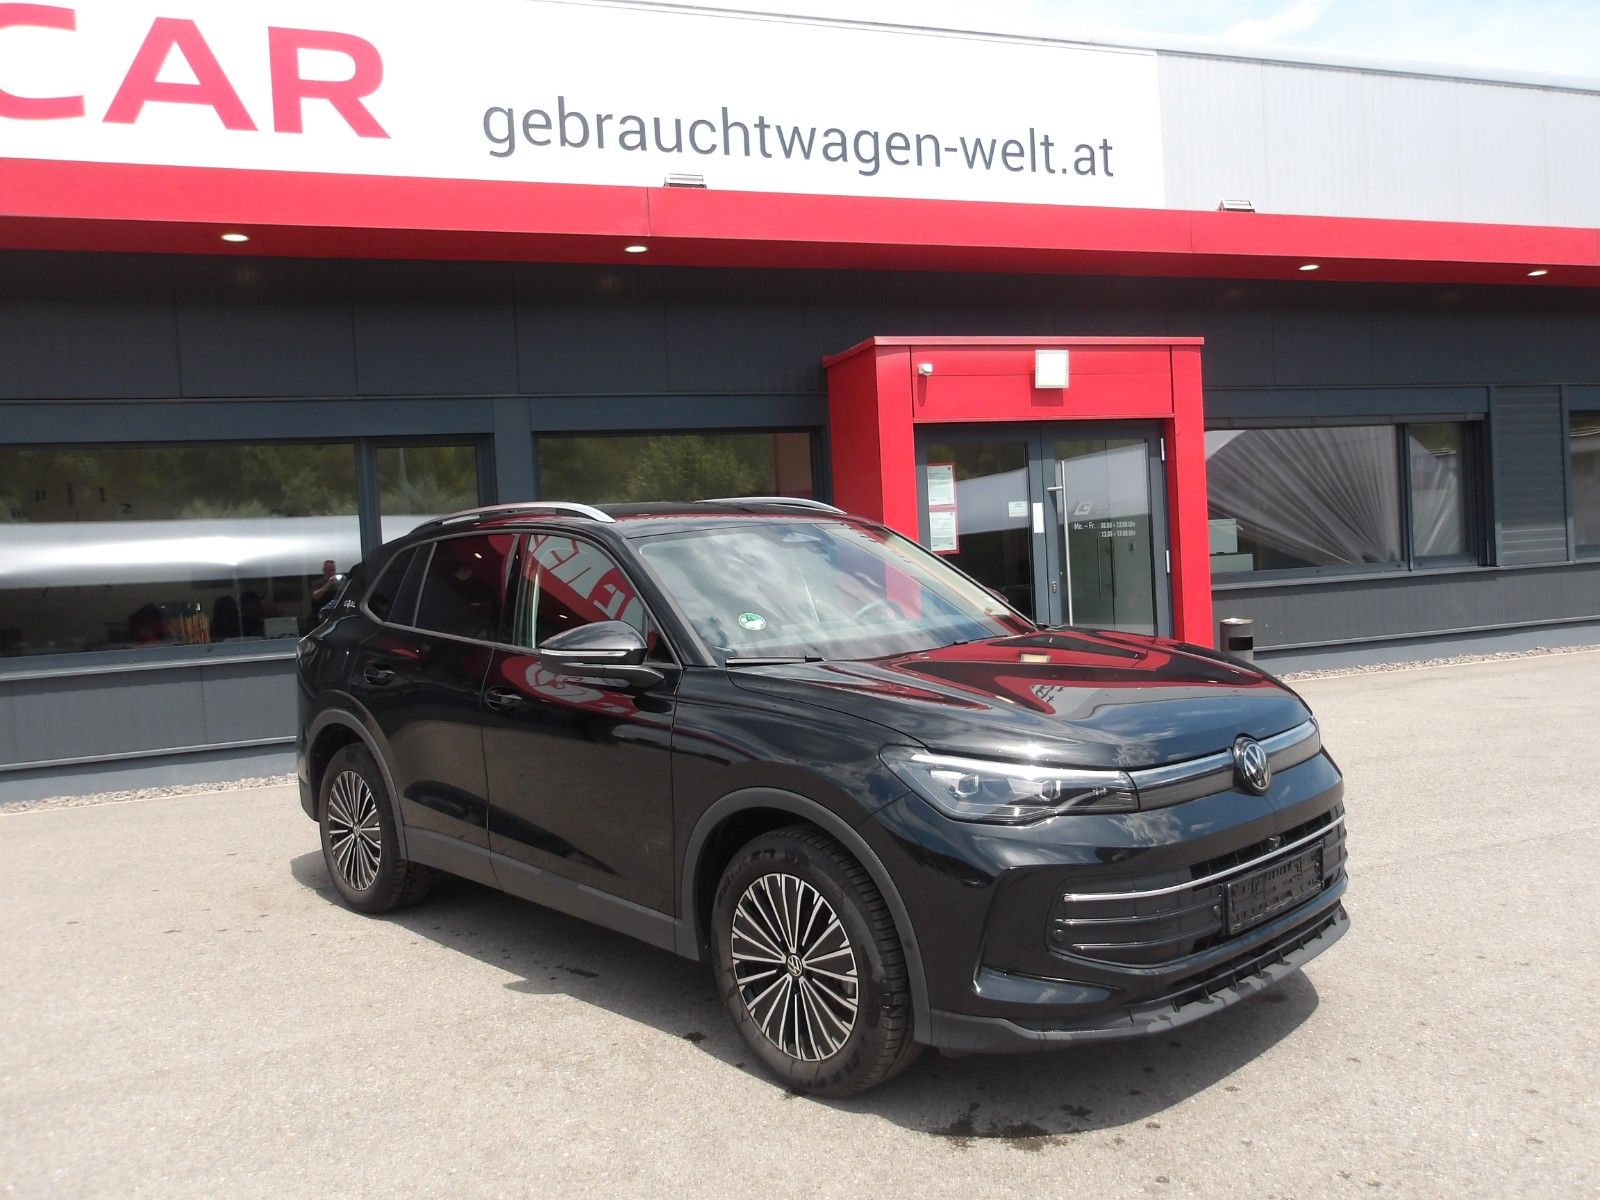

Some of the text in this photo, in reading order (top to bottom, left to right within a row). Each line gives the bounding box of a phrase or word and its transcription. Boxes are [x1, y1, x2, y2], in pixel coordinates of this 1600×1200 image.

[0, 3, 391, 139] CAR
[483, 96, 1114, 177] gebrauchtwagen-welt.at
[1073, 522, 1084, 531] Mo.
[1088, 521, 1096, 530] Fr.
